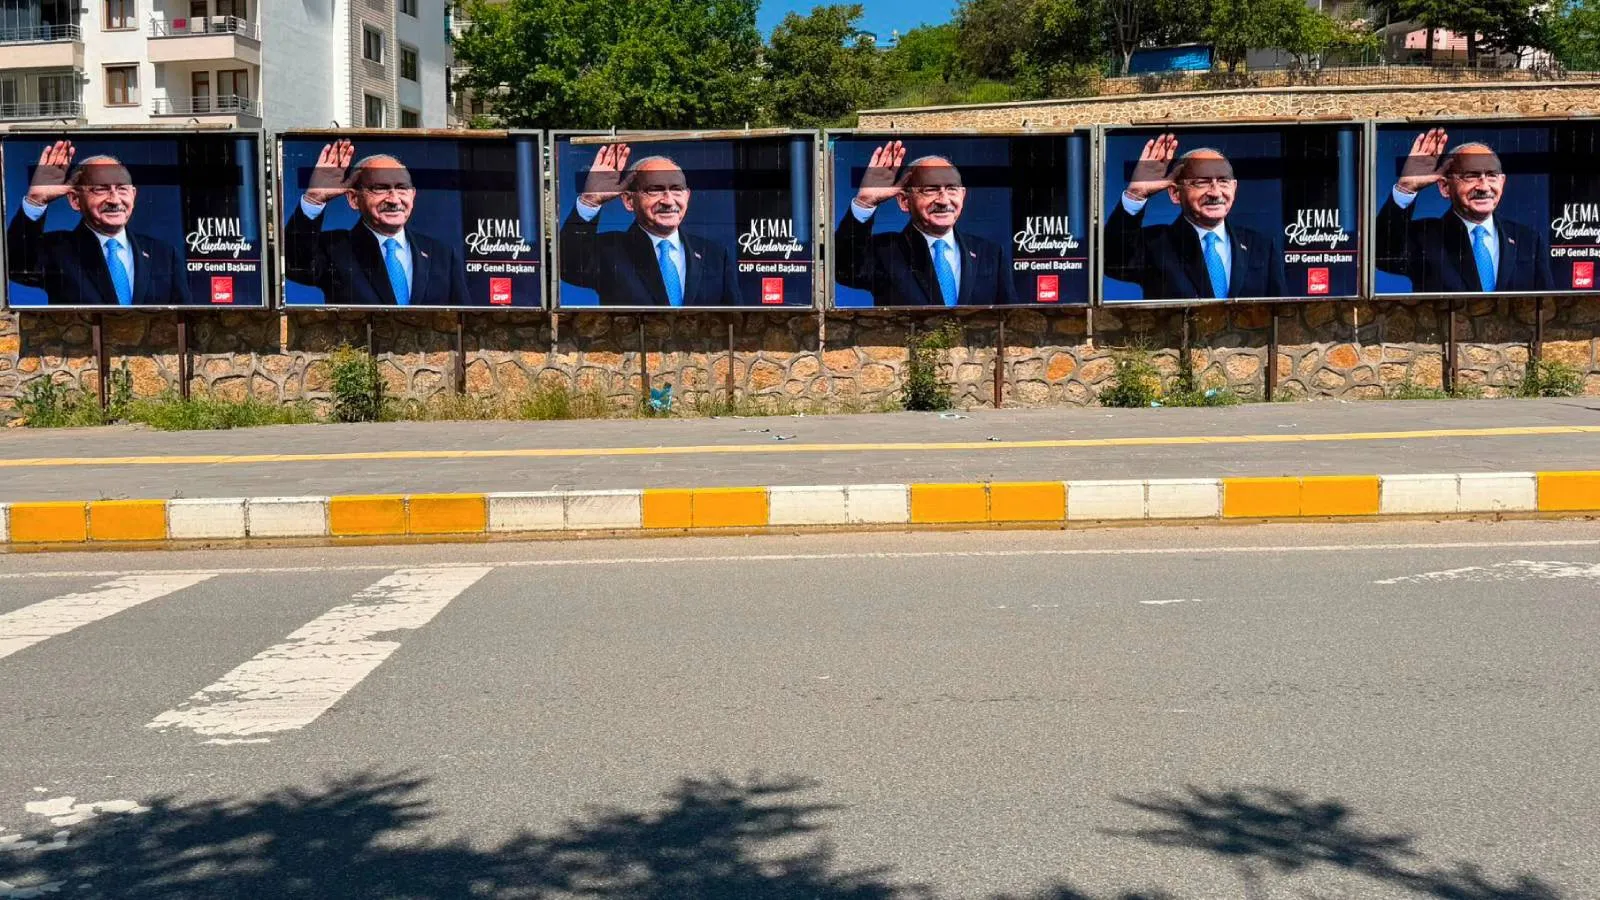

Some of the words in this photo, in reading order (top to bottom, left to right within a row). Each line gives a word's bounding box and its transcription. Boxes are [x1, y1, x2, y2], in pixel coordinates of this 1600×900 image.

[1298, 209, 1341, 228] KEMAL
[1564, 203, 1599, 222] KEMA
[198, 217, 243, 237] KEMAL
[478, 219, 522, 237] KEMAL
[751, 219, 795, 237] KEMAL
[1026, 216, 1070, 235] KEMAL
[1285, 254, 1300, 262] CHP
[1301, 254, 1322, 262] Genel
[1324, 254, 1352, 263] Başkanı
[1551, 248, 1566, 256] CHP
[1568, 248, 1588, 256] Genel
[187, 263, 203, 271] CHP
[204, 263, 225, 271] Genel
[228, 263, 255, 272] Başkanı
[467, 264, 482, 272] CHP
[483, 264, 504, 272] Genel
[506, 265, 535, 273] Başkanı
[739, 264, 754, 272] CHP
[756, 264, 776, 272] Genel
[778, 264, 806, 273] Başkanı
[1014, 262, 1029, 270] CHP
[1054, 262, 1082, 270] Başkanı
